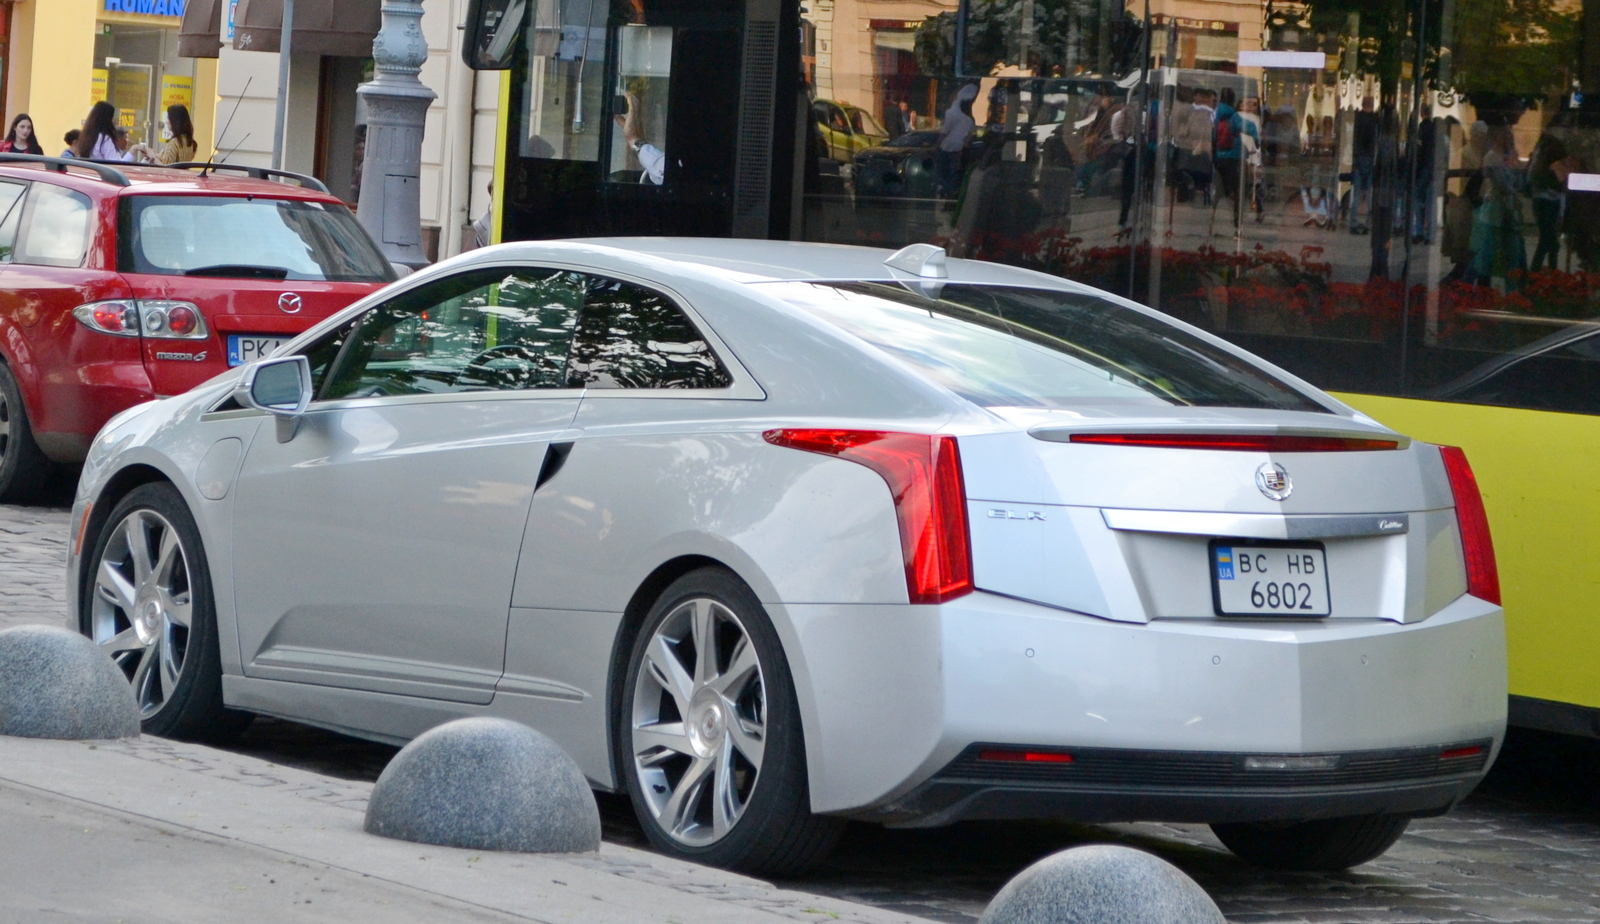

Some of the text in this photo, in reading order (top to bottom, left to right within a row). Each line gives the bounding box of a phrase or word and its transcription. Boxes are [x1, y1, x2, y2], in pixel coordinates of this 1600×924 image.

[1219, 568, 1233, 579] UA
[1239, 553, 1315, 574] BC HB
[1251, 581, 1313, 610] 6802
